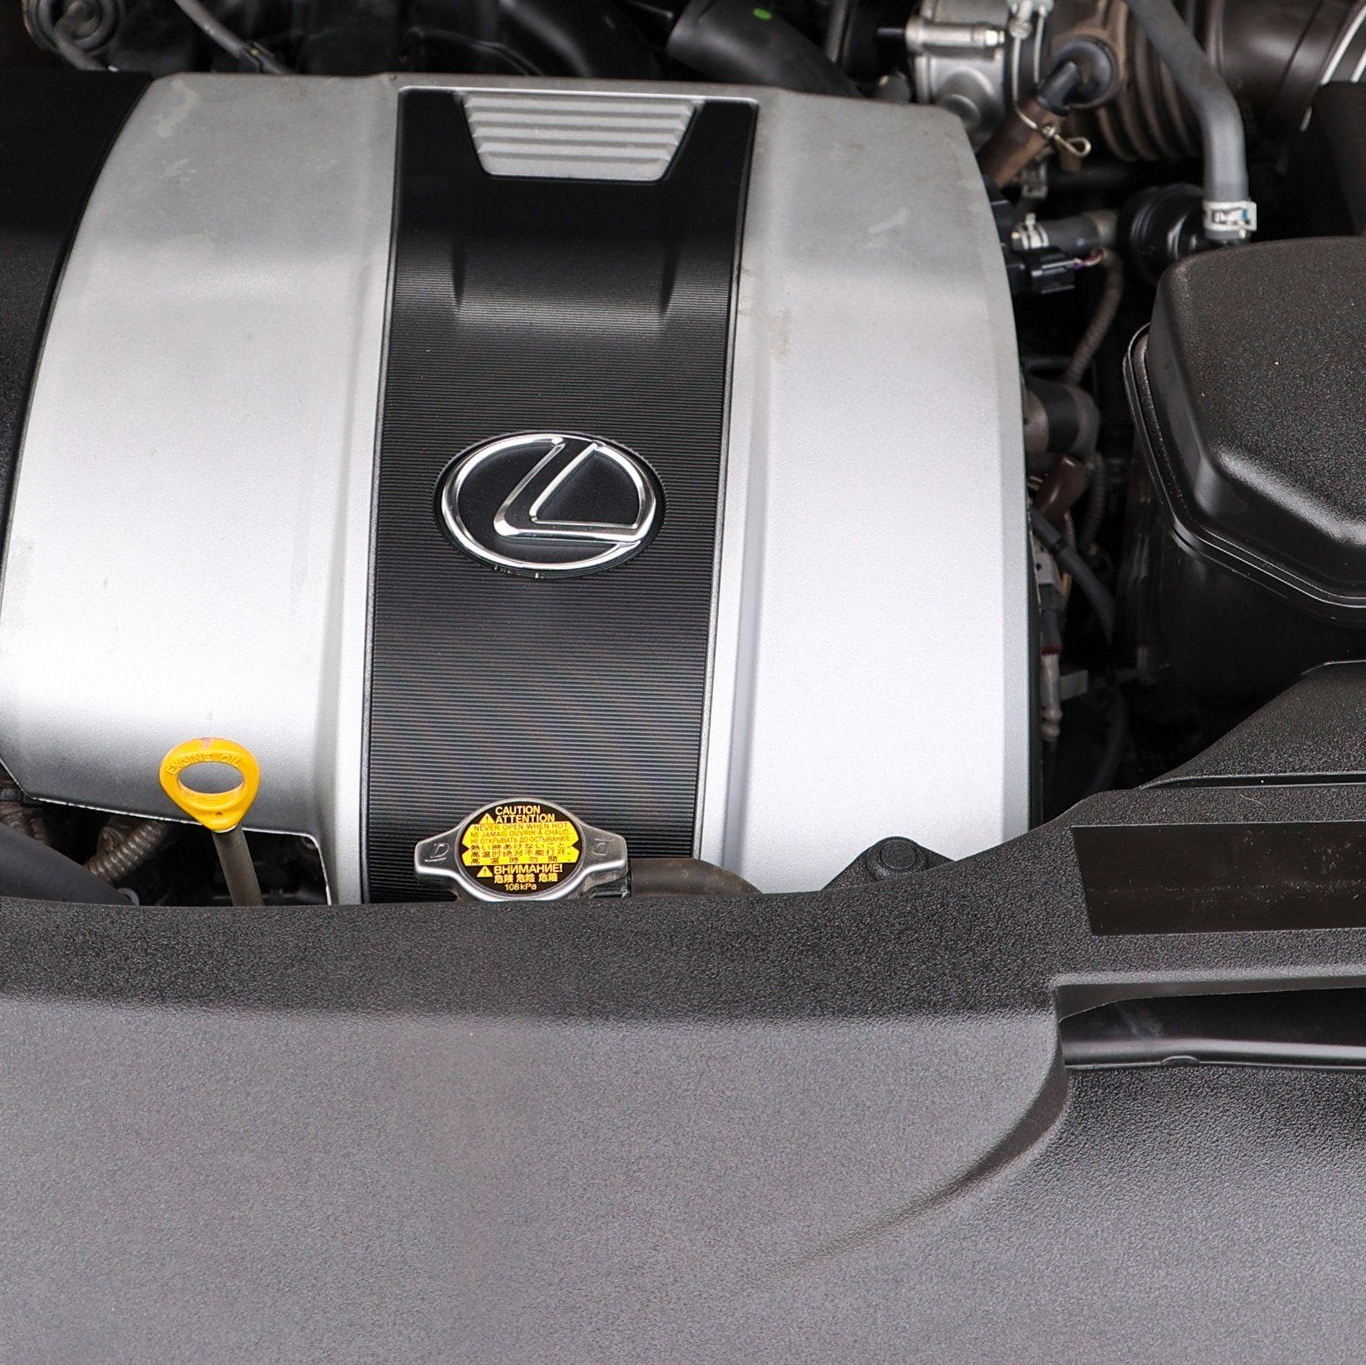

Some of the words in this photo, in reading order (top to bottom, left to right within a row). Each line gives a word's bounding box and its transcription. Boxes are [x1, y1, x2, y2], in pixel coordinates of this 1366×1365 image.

[167, 754, 212, 775] ENGINE
[495, 805, 541, 816] CAUTION
[495, 813, 555, 824] ATTENTION
[474, 824, 501, 832] NEVER
[493, 863, 563, 874] ВНИМАНИЕ!
